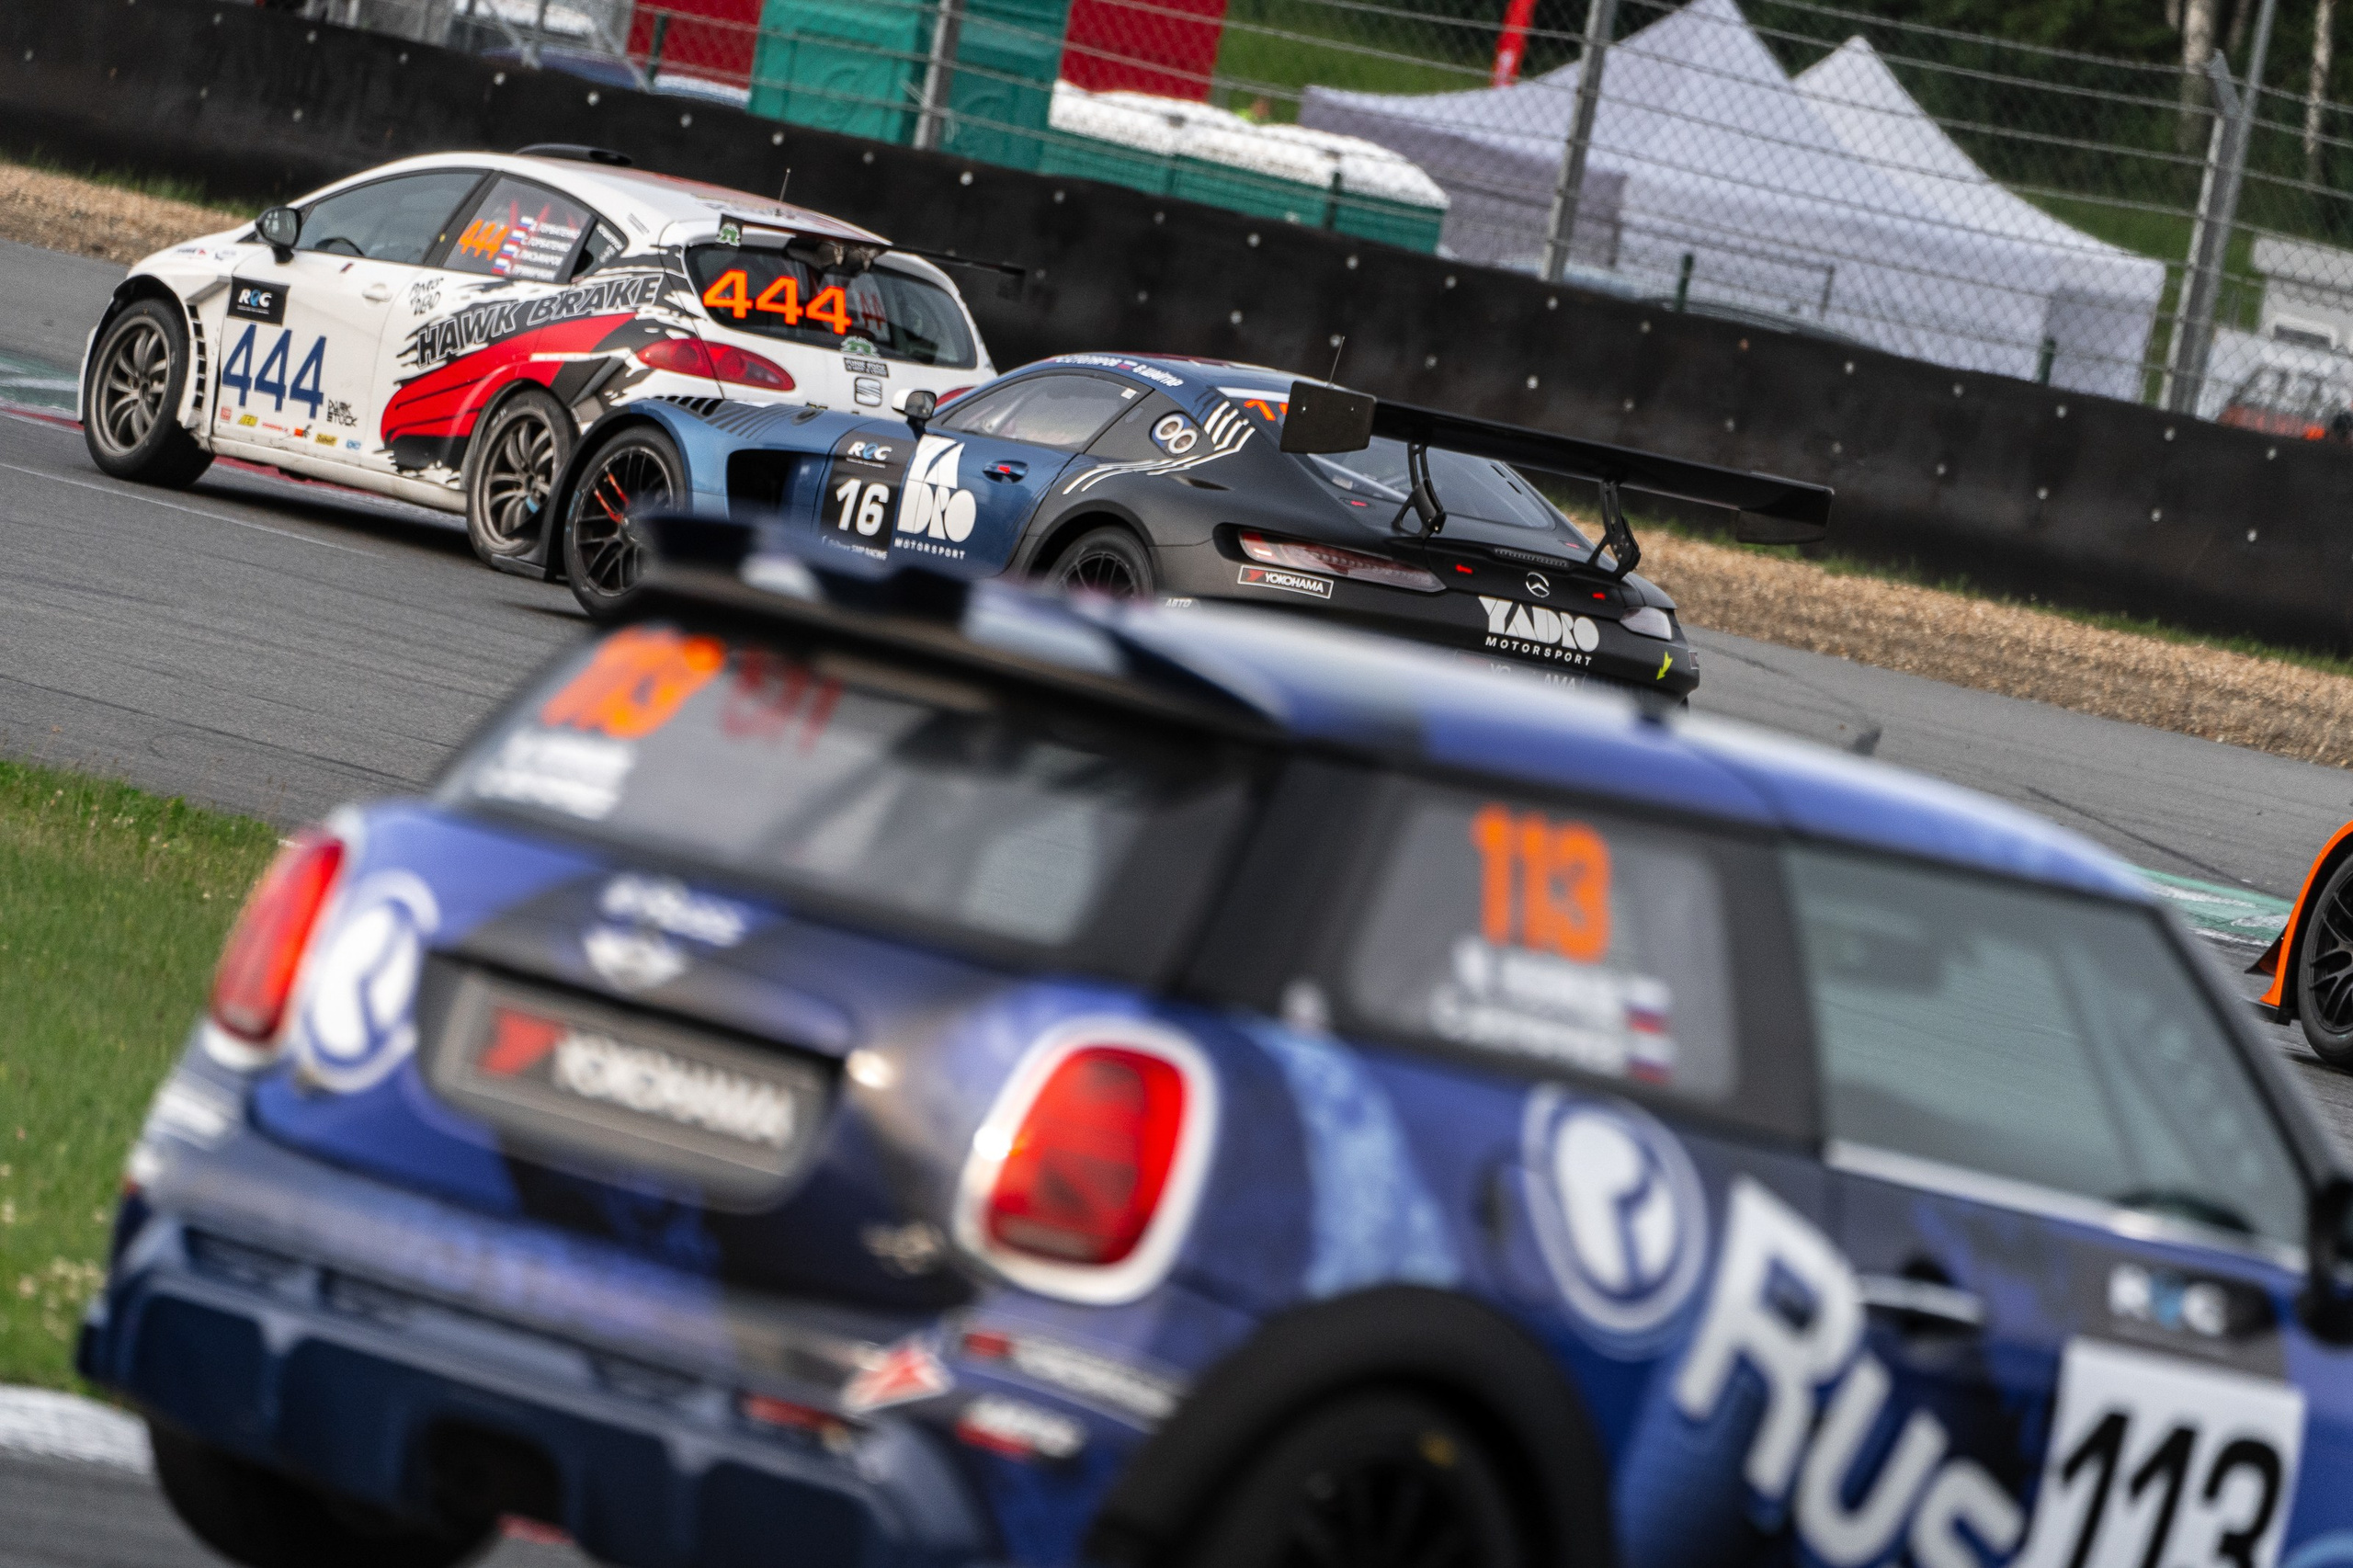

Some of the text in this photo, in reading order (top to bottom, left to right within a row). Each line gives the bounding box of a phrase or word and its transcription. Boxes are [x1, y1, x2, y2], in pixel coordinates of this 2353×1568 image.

[459, 219, 509, 261] 444
[416, 273, 665, 369] HAWK BRAKE
[702, 269, 852, 335] 444
[222, 323, 326, 418] 444
[835, 478, 890, 537] 16
[893, 536, 966, 560] MOTORSPORT
[1265, 572, 1324, 593] YOKOHAMA
[1478, 596, 1599, 652] YADRO
[1484, 636, 1592, 665] MOTORSPORT
[1473, 801, 1610, 965] 113
[2062, 1409, 2282, 1568] 113
